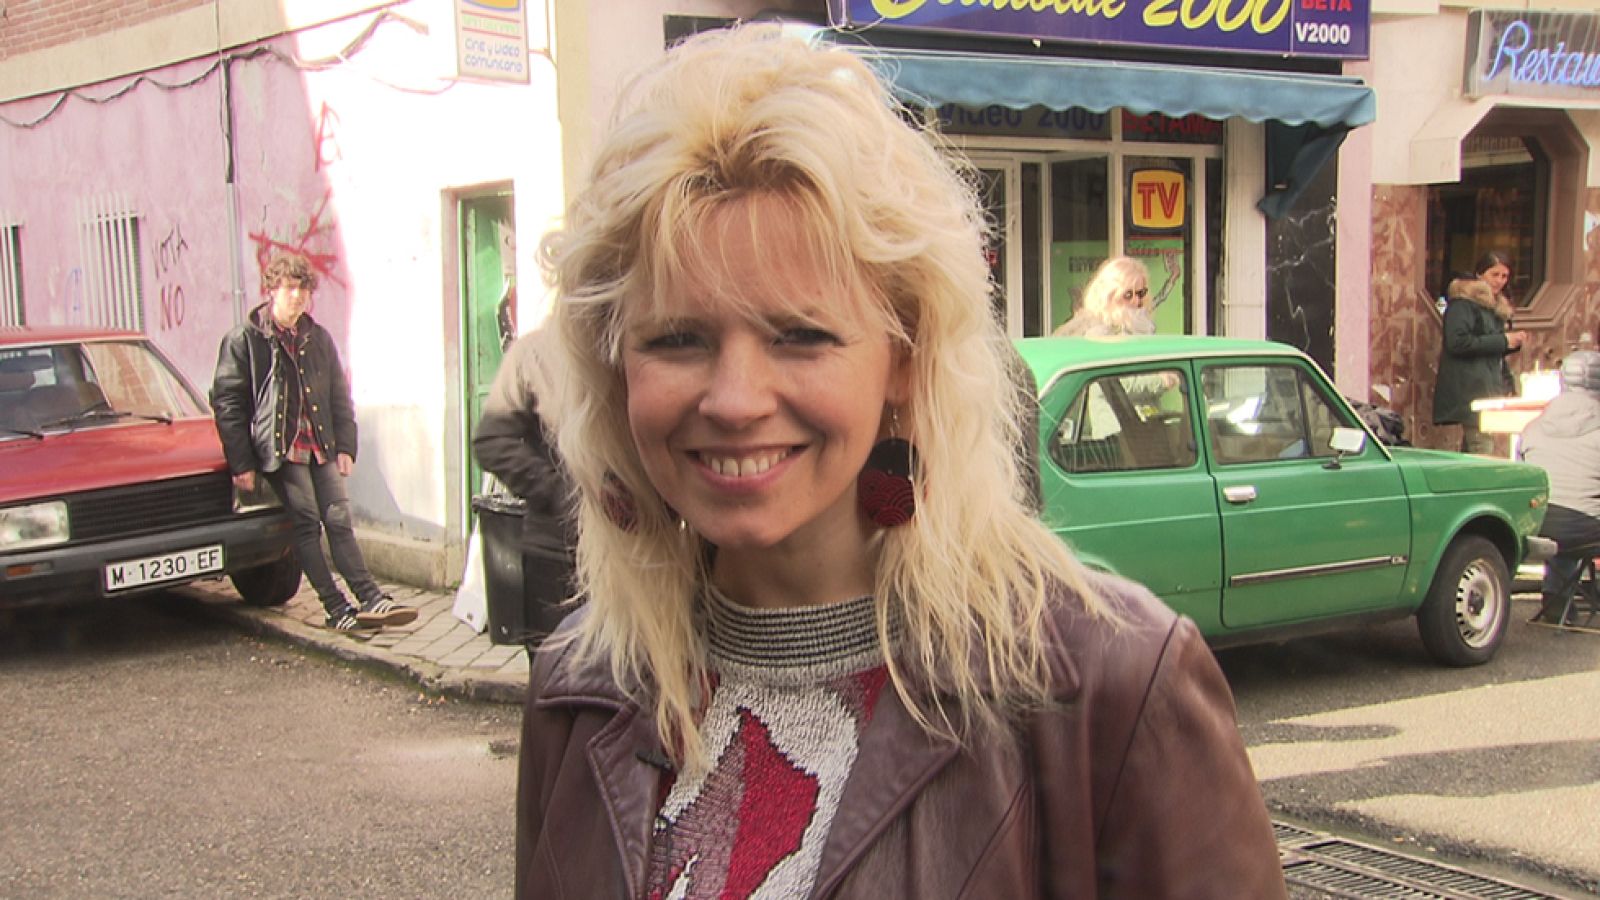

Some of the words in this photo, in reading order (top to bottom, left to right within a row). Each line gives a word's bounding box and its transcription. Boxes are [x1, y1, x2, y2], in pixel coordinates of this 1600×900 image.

[1295, 22, 1351, 45] V2000
[1137, 181, 1181, 220] TV
[160, 282, 185, 331] NO
[111, 566, 125, 586] M
[139, 556, 187, 580] 1230
[197, 548, 220, 570] EF
